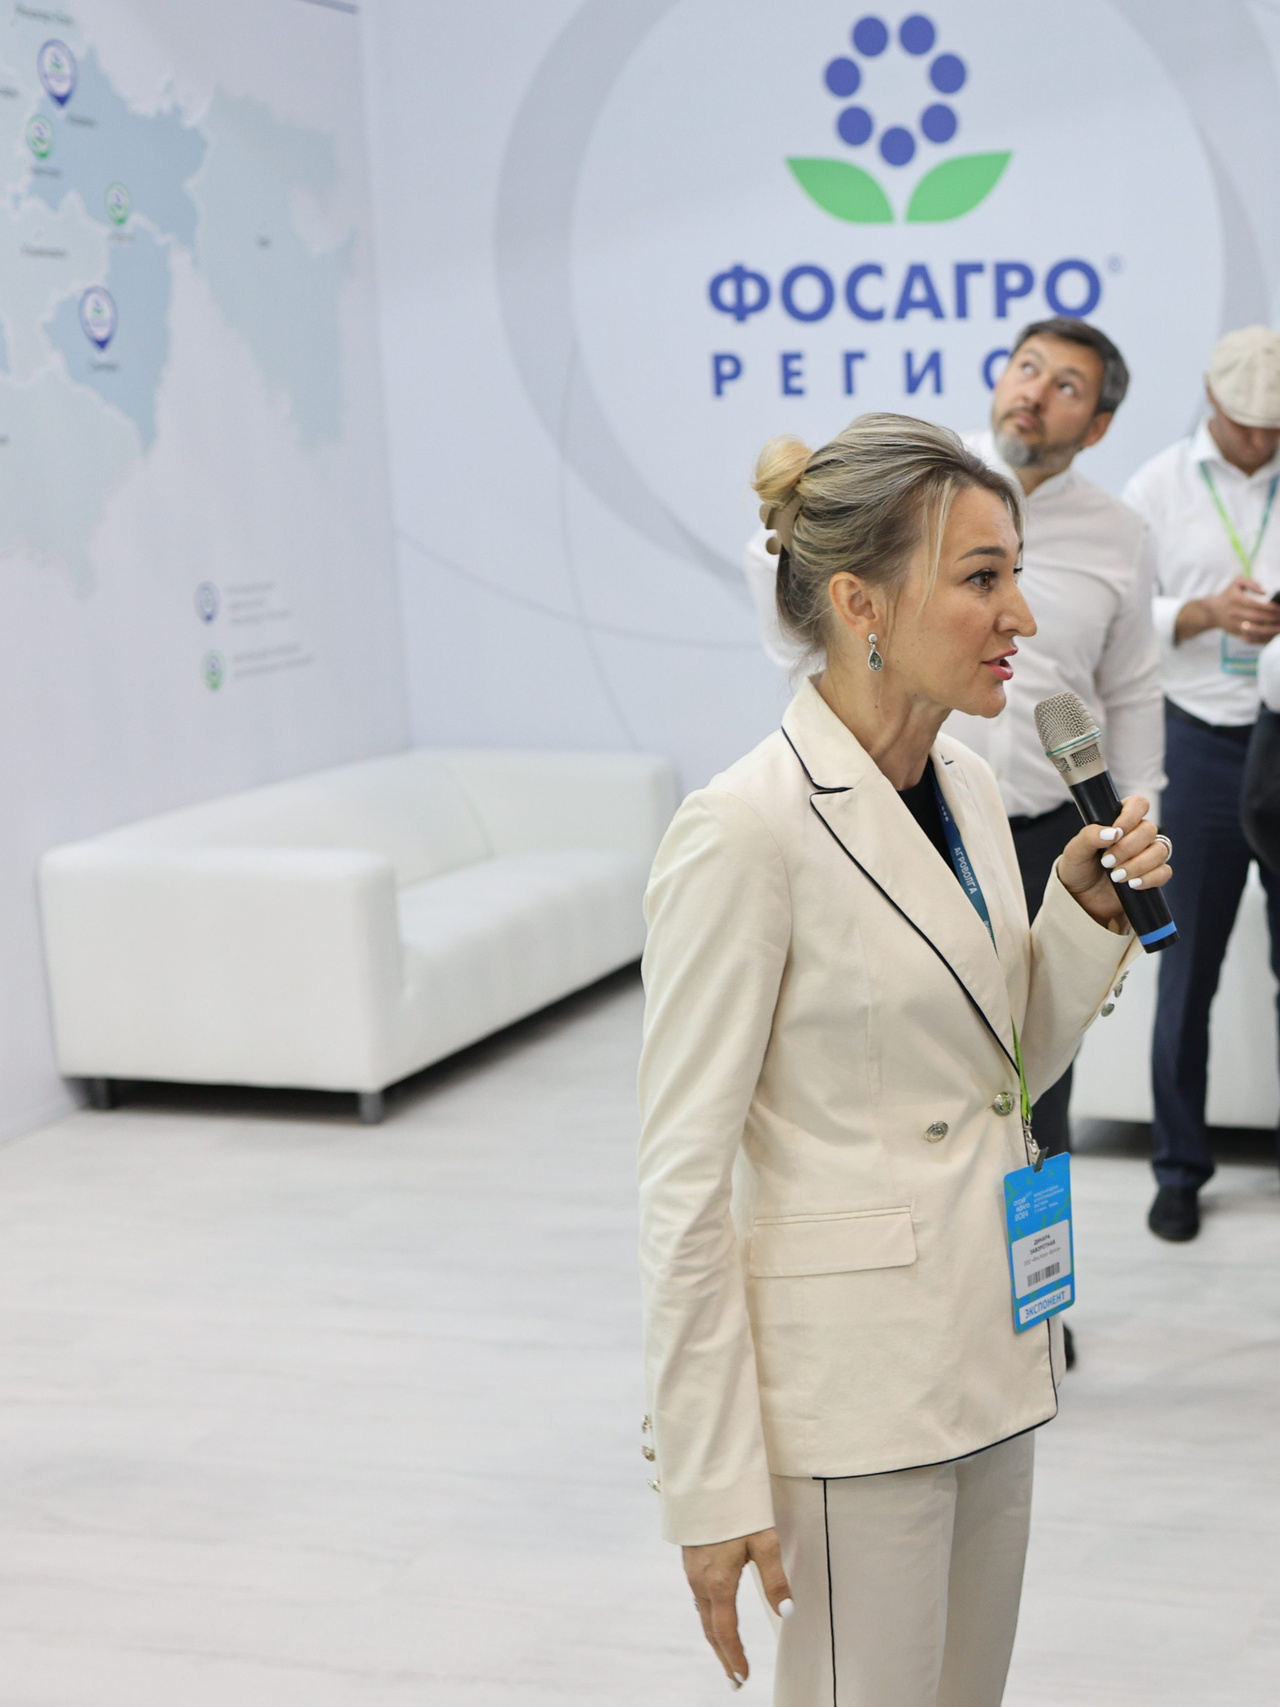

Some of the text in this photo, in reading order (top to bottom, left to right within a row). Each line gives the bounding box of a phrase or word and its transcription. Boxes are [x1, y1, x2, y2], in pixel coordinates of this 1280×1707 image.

[708, 259, 1104, 323] ФОСАГРО
[953, 846, 978, 895] АГРОВОЛГА
[1024, 1290, 1066, 1319] ЭКСПОНЕНТ
